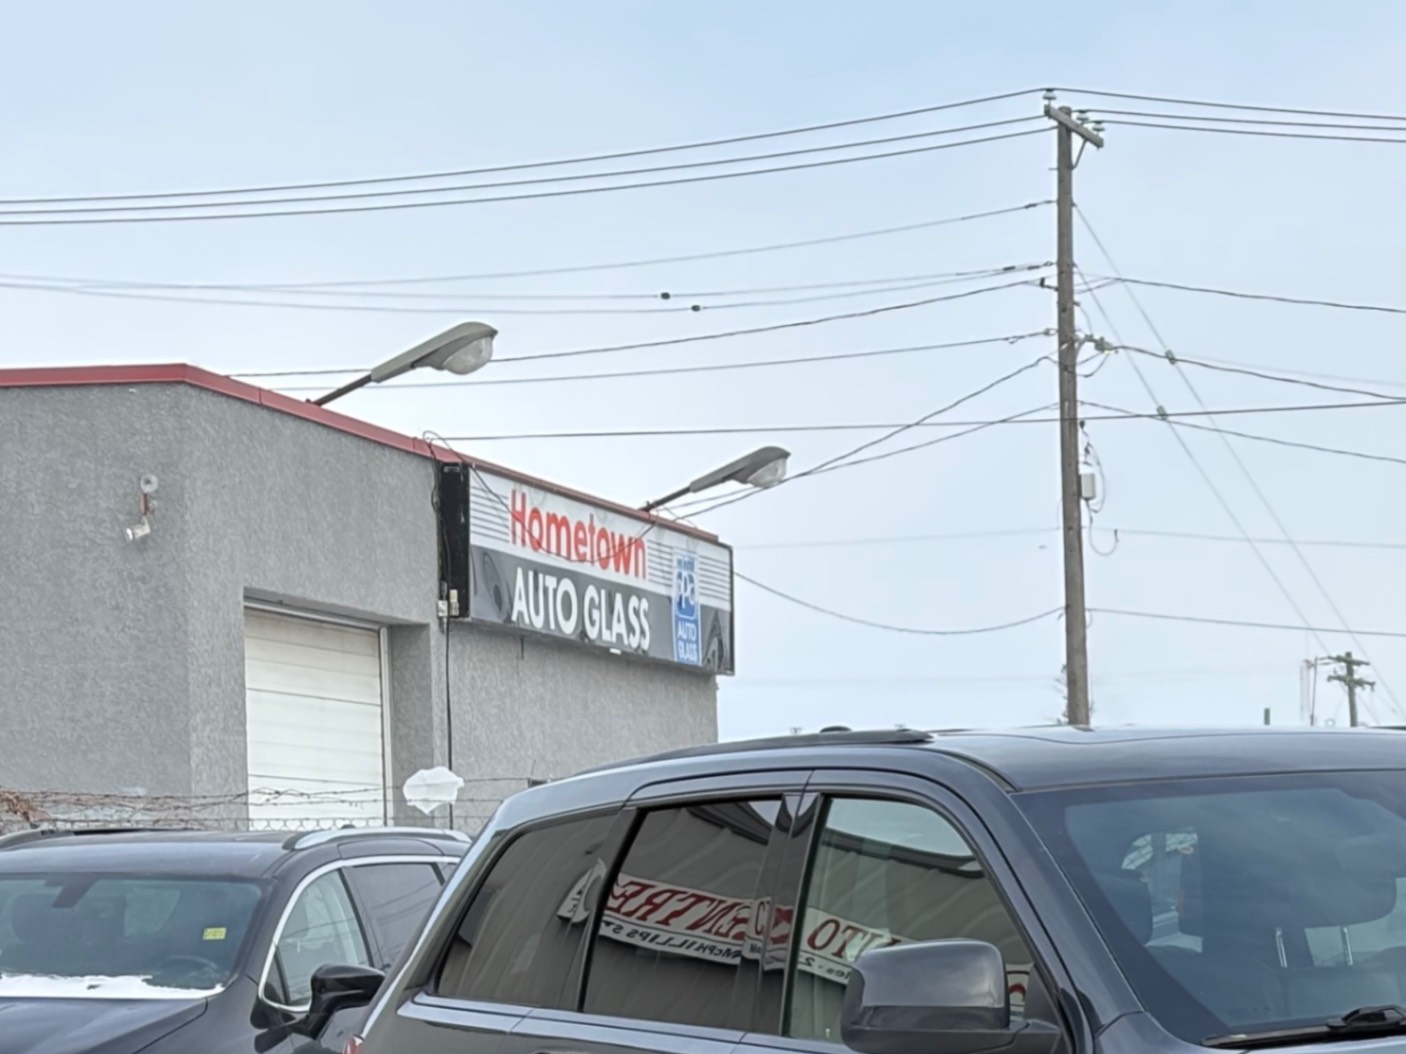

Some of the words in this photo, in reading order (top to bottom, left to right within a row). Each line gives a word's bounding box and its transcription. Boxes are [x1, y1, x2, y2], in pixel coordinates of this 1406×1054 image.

[509, 489, 648, 581] Hometown
[511, 567, 579, 635] AUTO
[583, 584, 650, 651] GLASS
